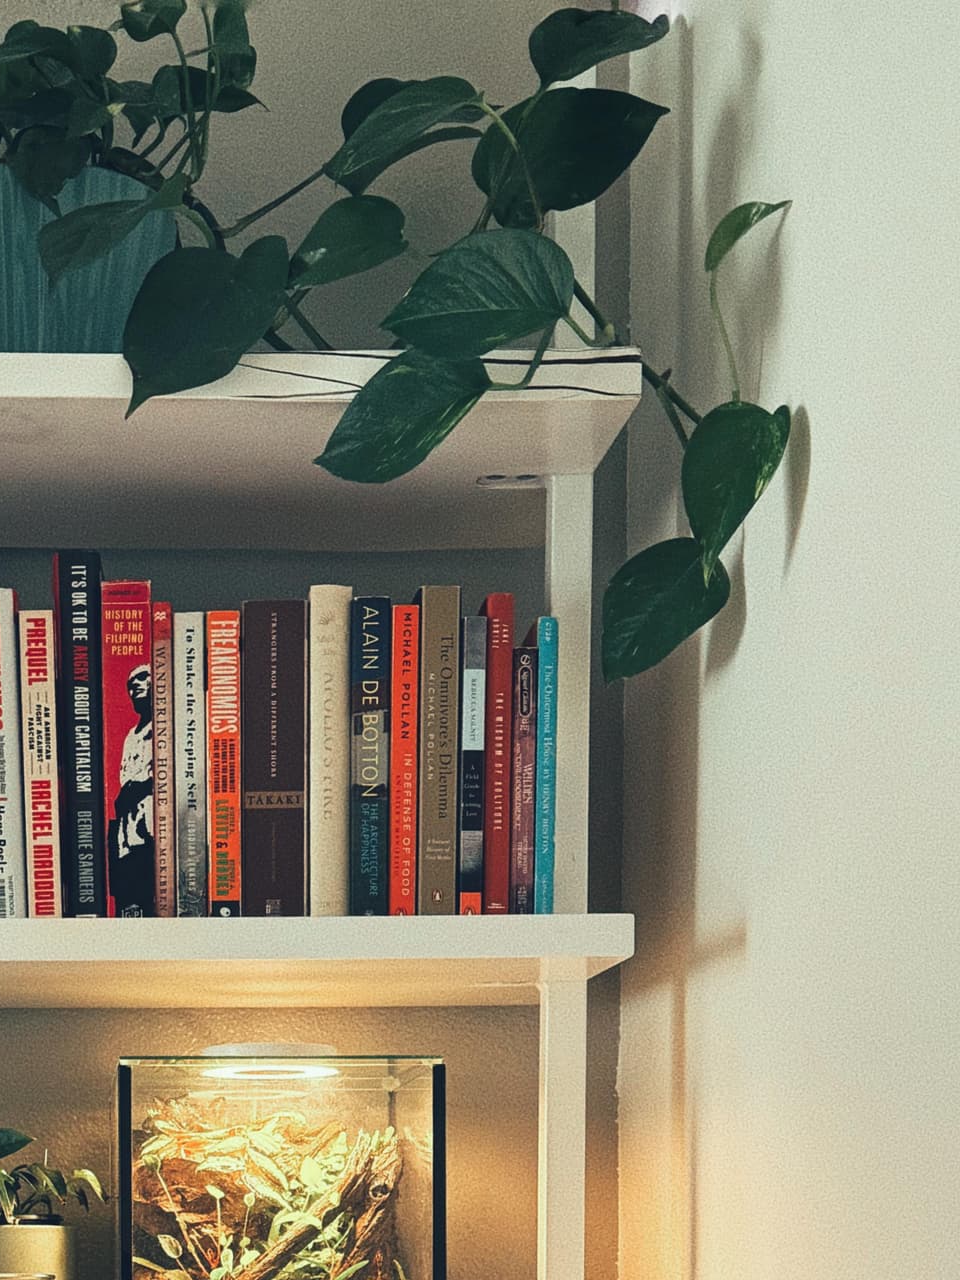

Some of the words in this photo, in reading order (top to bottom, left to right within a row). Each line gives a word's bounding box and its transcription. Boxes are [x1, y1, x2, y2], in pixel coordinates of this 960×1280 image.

[70, 565, 87, 588] IT'S
[71, 591, 87, 607] OK
[72, 610, 87, 624] TO
[104, 609, 143, 620] HISTORY
[25, 618, 48, 686] PREQUEL
[72, 627, 88, 642] BE
[105, 633, 144, 645] FILIPINO
[111, 645, 144, 656] PEOPLE
[362, 605, 380, 670] ALAIN
[402, 611, 413, 677] MICHAEL
[440, 633, 454, 663] The
[72, 645, 89, 682] ANGRY
[210, 620, 238, 734] FREAKONOMICS
[73, 686, 90, 722] ABOUT
[155, 646, 167, 750] WANDERING
[362, 680, 379, 706] DE
[400, 682, 411, 740] POLLAN
[439, 666, 455, 748] Omnivore's
[74, 724, 92, 793] CAPITALISM
[361, 713, 379, 798] BOTTON
[403, 753, 413, 767] IN
[157, 757, 167, 806] HOME
[247, 795, 301, 806] TAKAKI
[402, 771, 413, 832] DEFENSE
[438, 753, 453, 819] Dilemma
[31, 779, 53, 841] RACHEL
[77, 810, 93, 850] BERNIE
[402, 837, 411, 854] OF
[33, 844, 55, 917] MADDOW
[78, 852, 95, 904] SANDERS
[401, 860, 411, 896] FOOD
